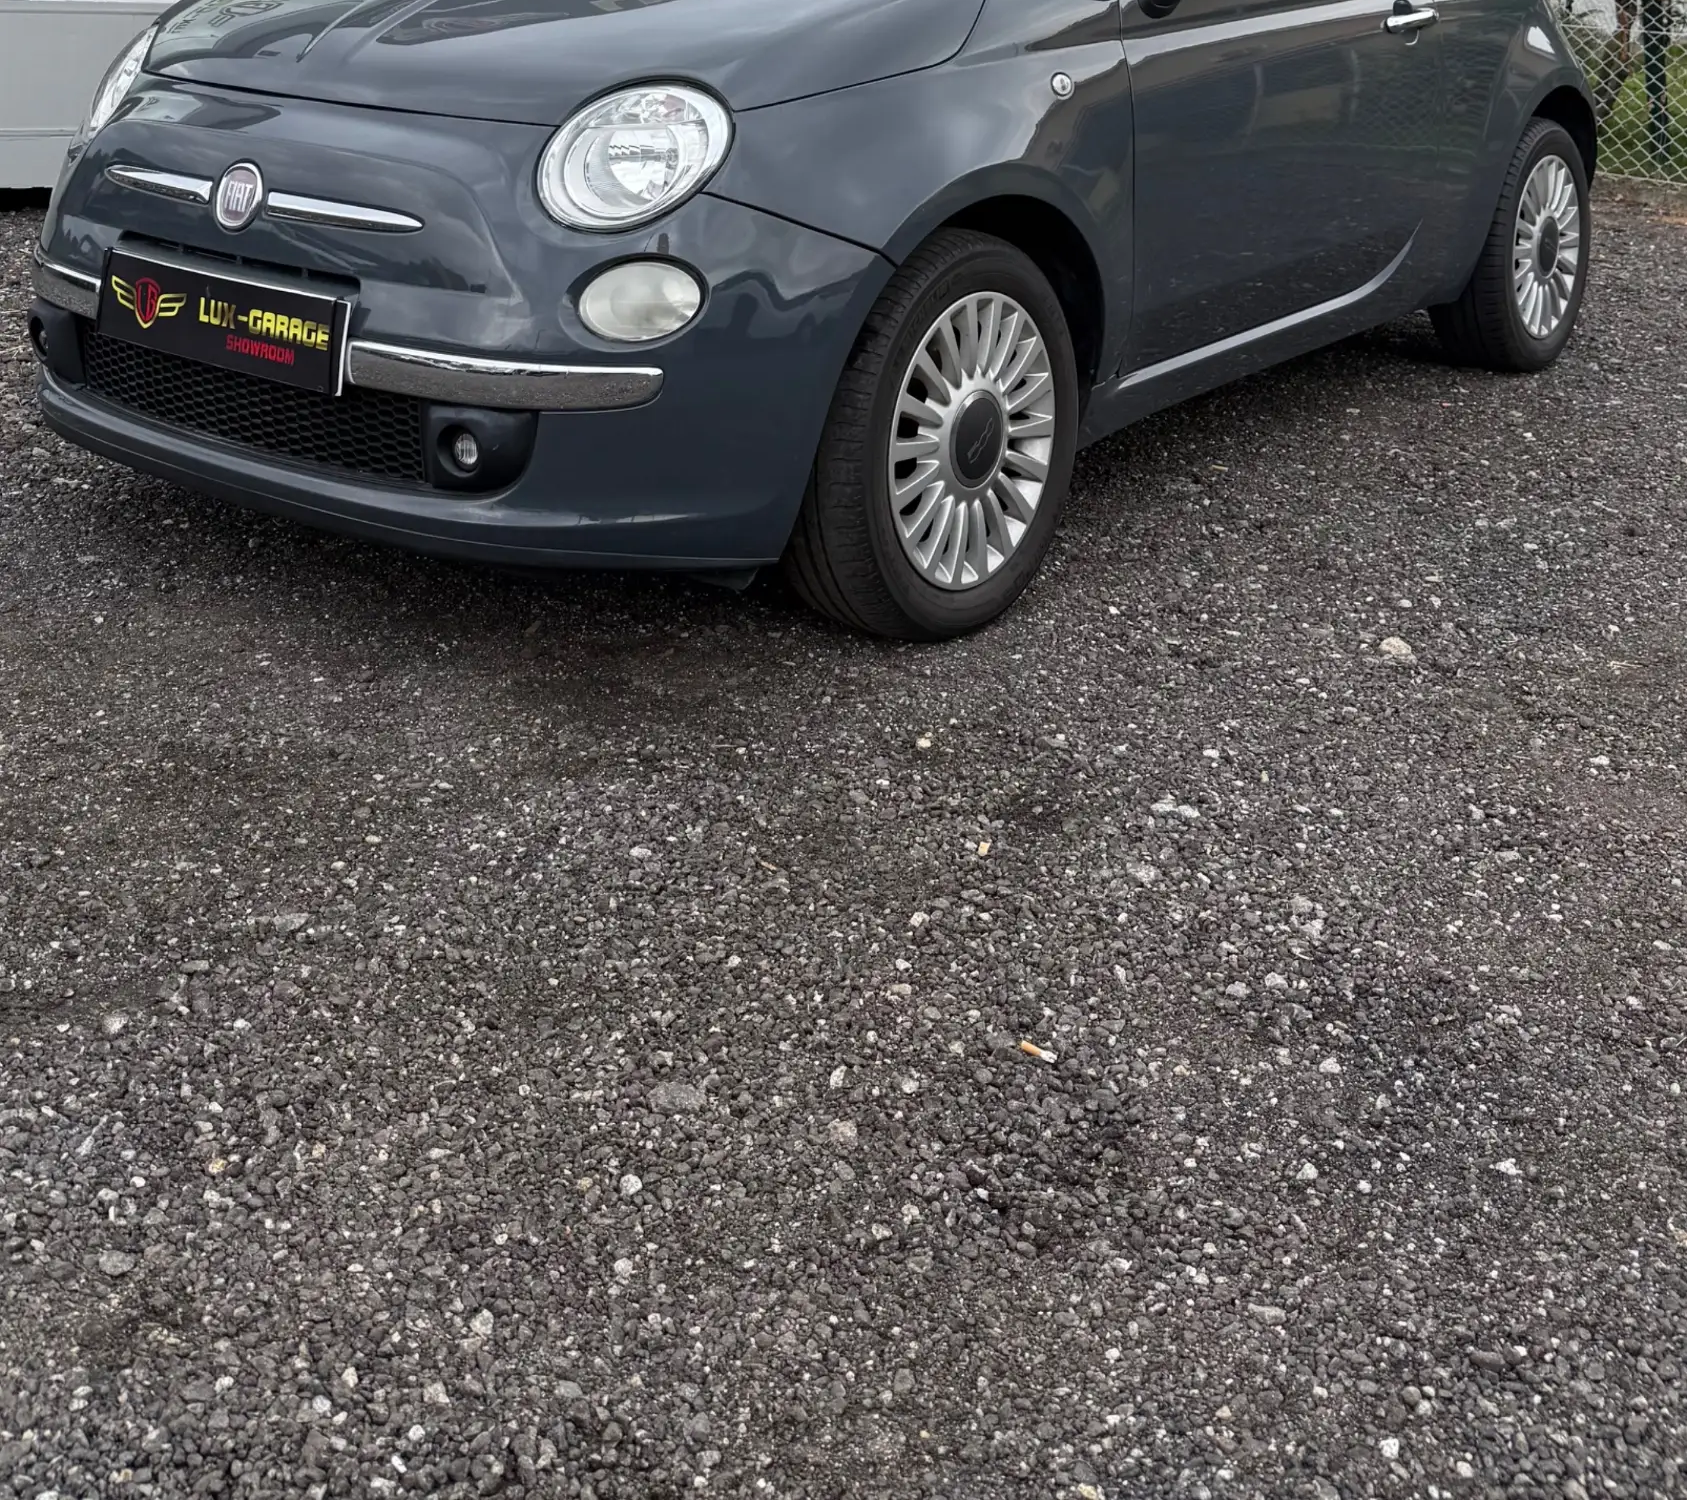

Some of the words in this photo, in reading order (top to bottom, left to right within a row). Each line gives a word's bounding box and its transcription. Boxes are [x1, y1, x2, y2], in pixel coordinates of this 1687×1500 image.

[224, 180, 254, 213] FIAT
[199, 296, 331, 352] LUX-GARAGE
[225, 334, 296, 366] SHOWROOM
